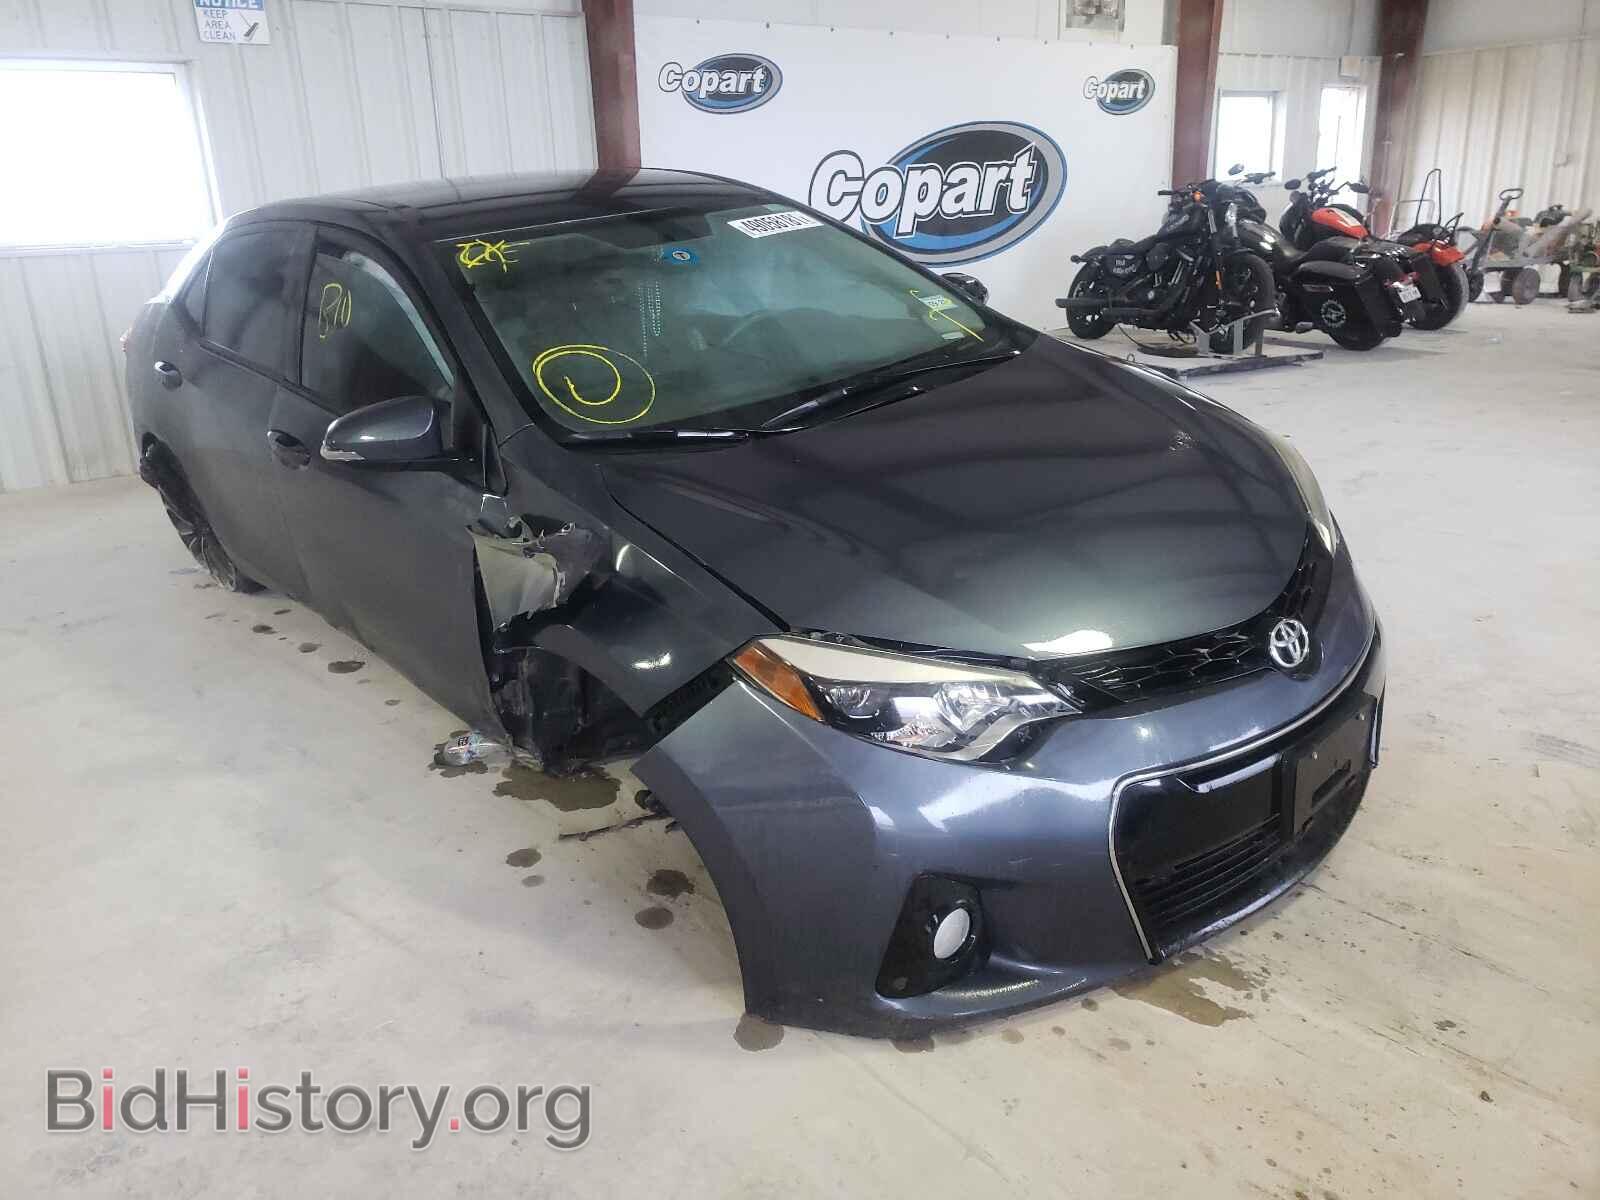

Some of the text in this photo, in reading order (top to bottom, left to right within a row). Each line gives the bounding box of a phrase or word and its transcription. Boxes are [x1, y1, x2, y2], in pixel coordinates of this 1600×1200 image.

[203, 9, 227, 19] KEEP
[205, 20, 232, 30] AREA
[203, 31, 236, 40] CLEAN
[658, 61, 768, 100] Copart
[1083, 75, 1146, 104] Copart
[808, 143, 1037, 238] Copart
